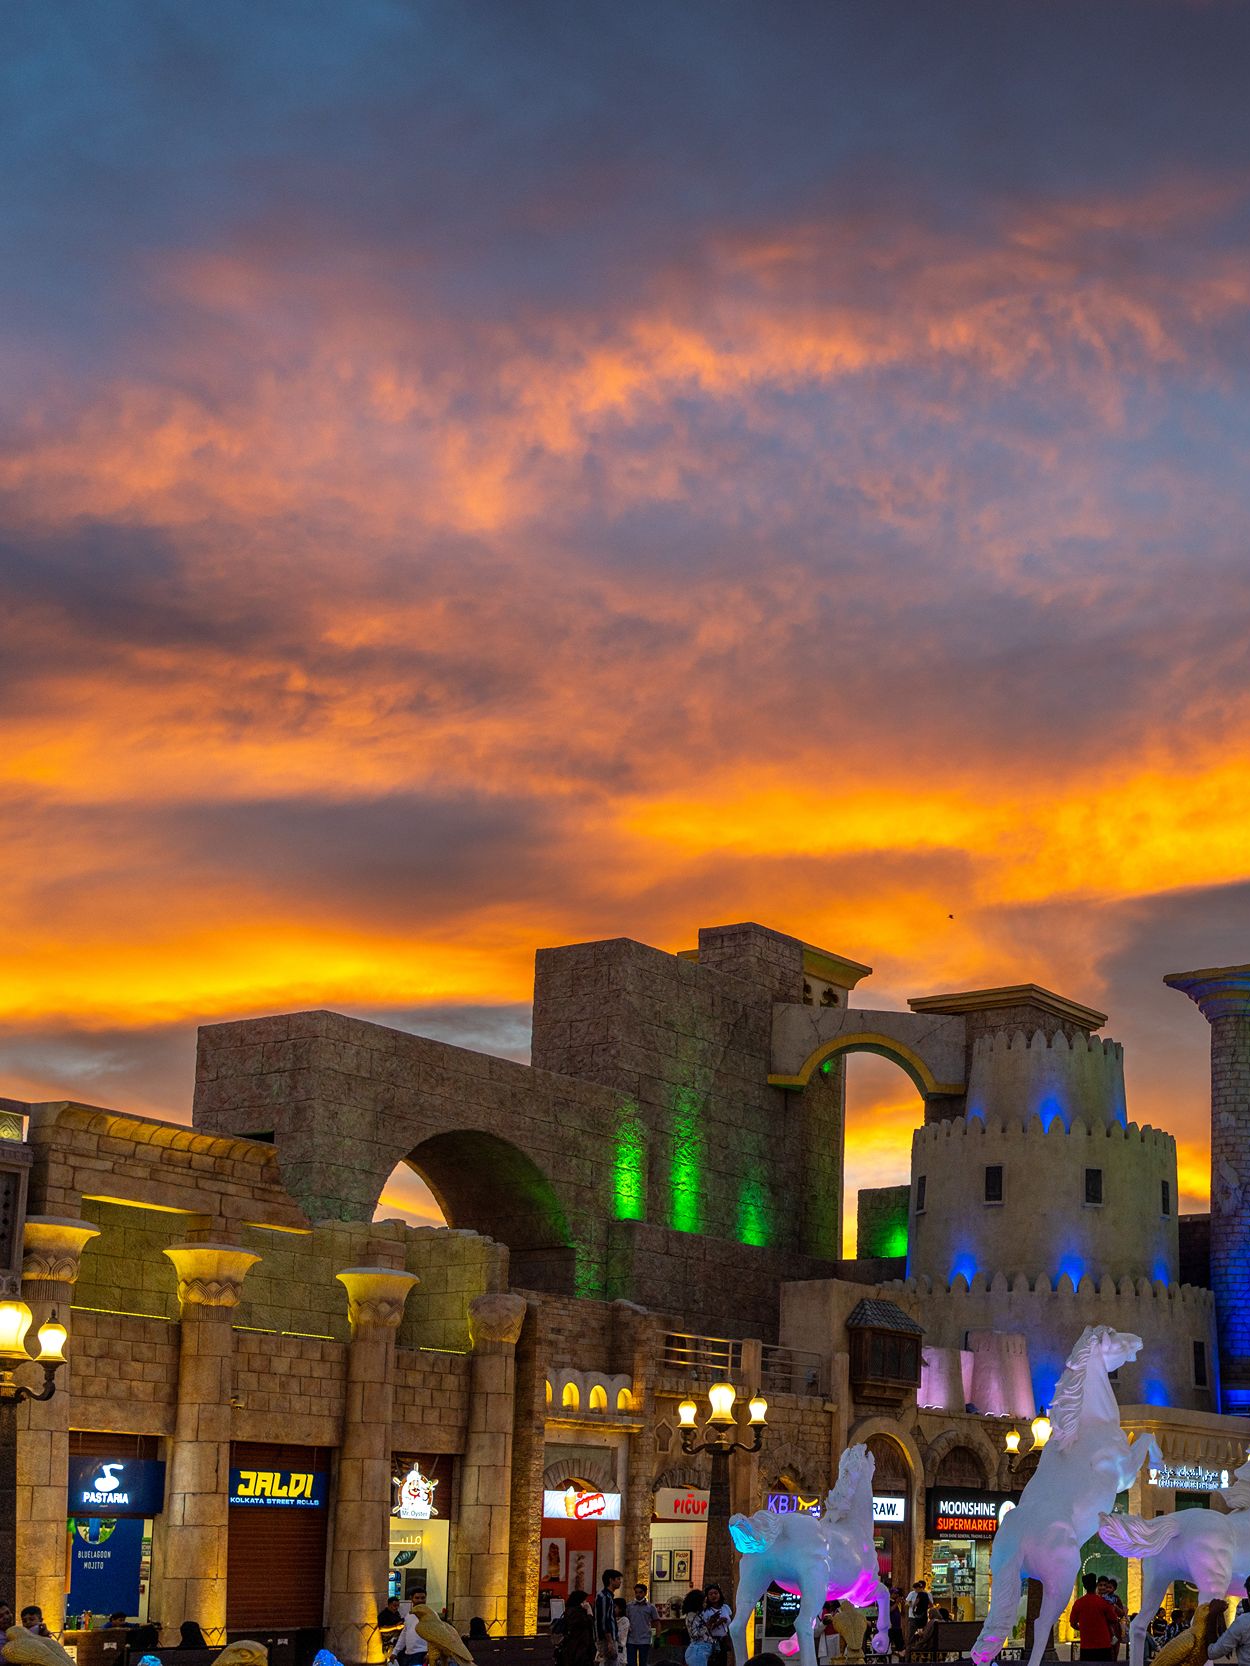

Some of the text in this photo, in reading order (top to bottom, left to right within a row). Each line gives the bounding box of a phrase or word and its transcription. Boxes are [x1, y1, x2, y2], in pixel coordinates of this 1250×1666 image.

[237, 1470, 314, 1498] JALDI
[83, 1491, 129, 1504] PASTARIA
[768, 1494, 798, 1514] KBJ
[940, 1500, 996, 1516] MOONSHINE
[937, 1517, 997, 1531] SUPERMARKET
[78, 1550, 112, 1559] BLUELAGOON
[83, 1561, 104, 1570] MOJITO
